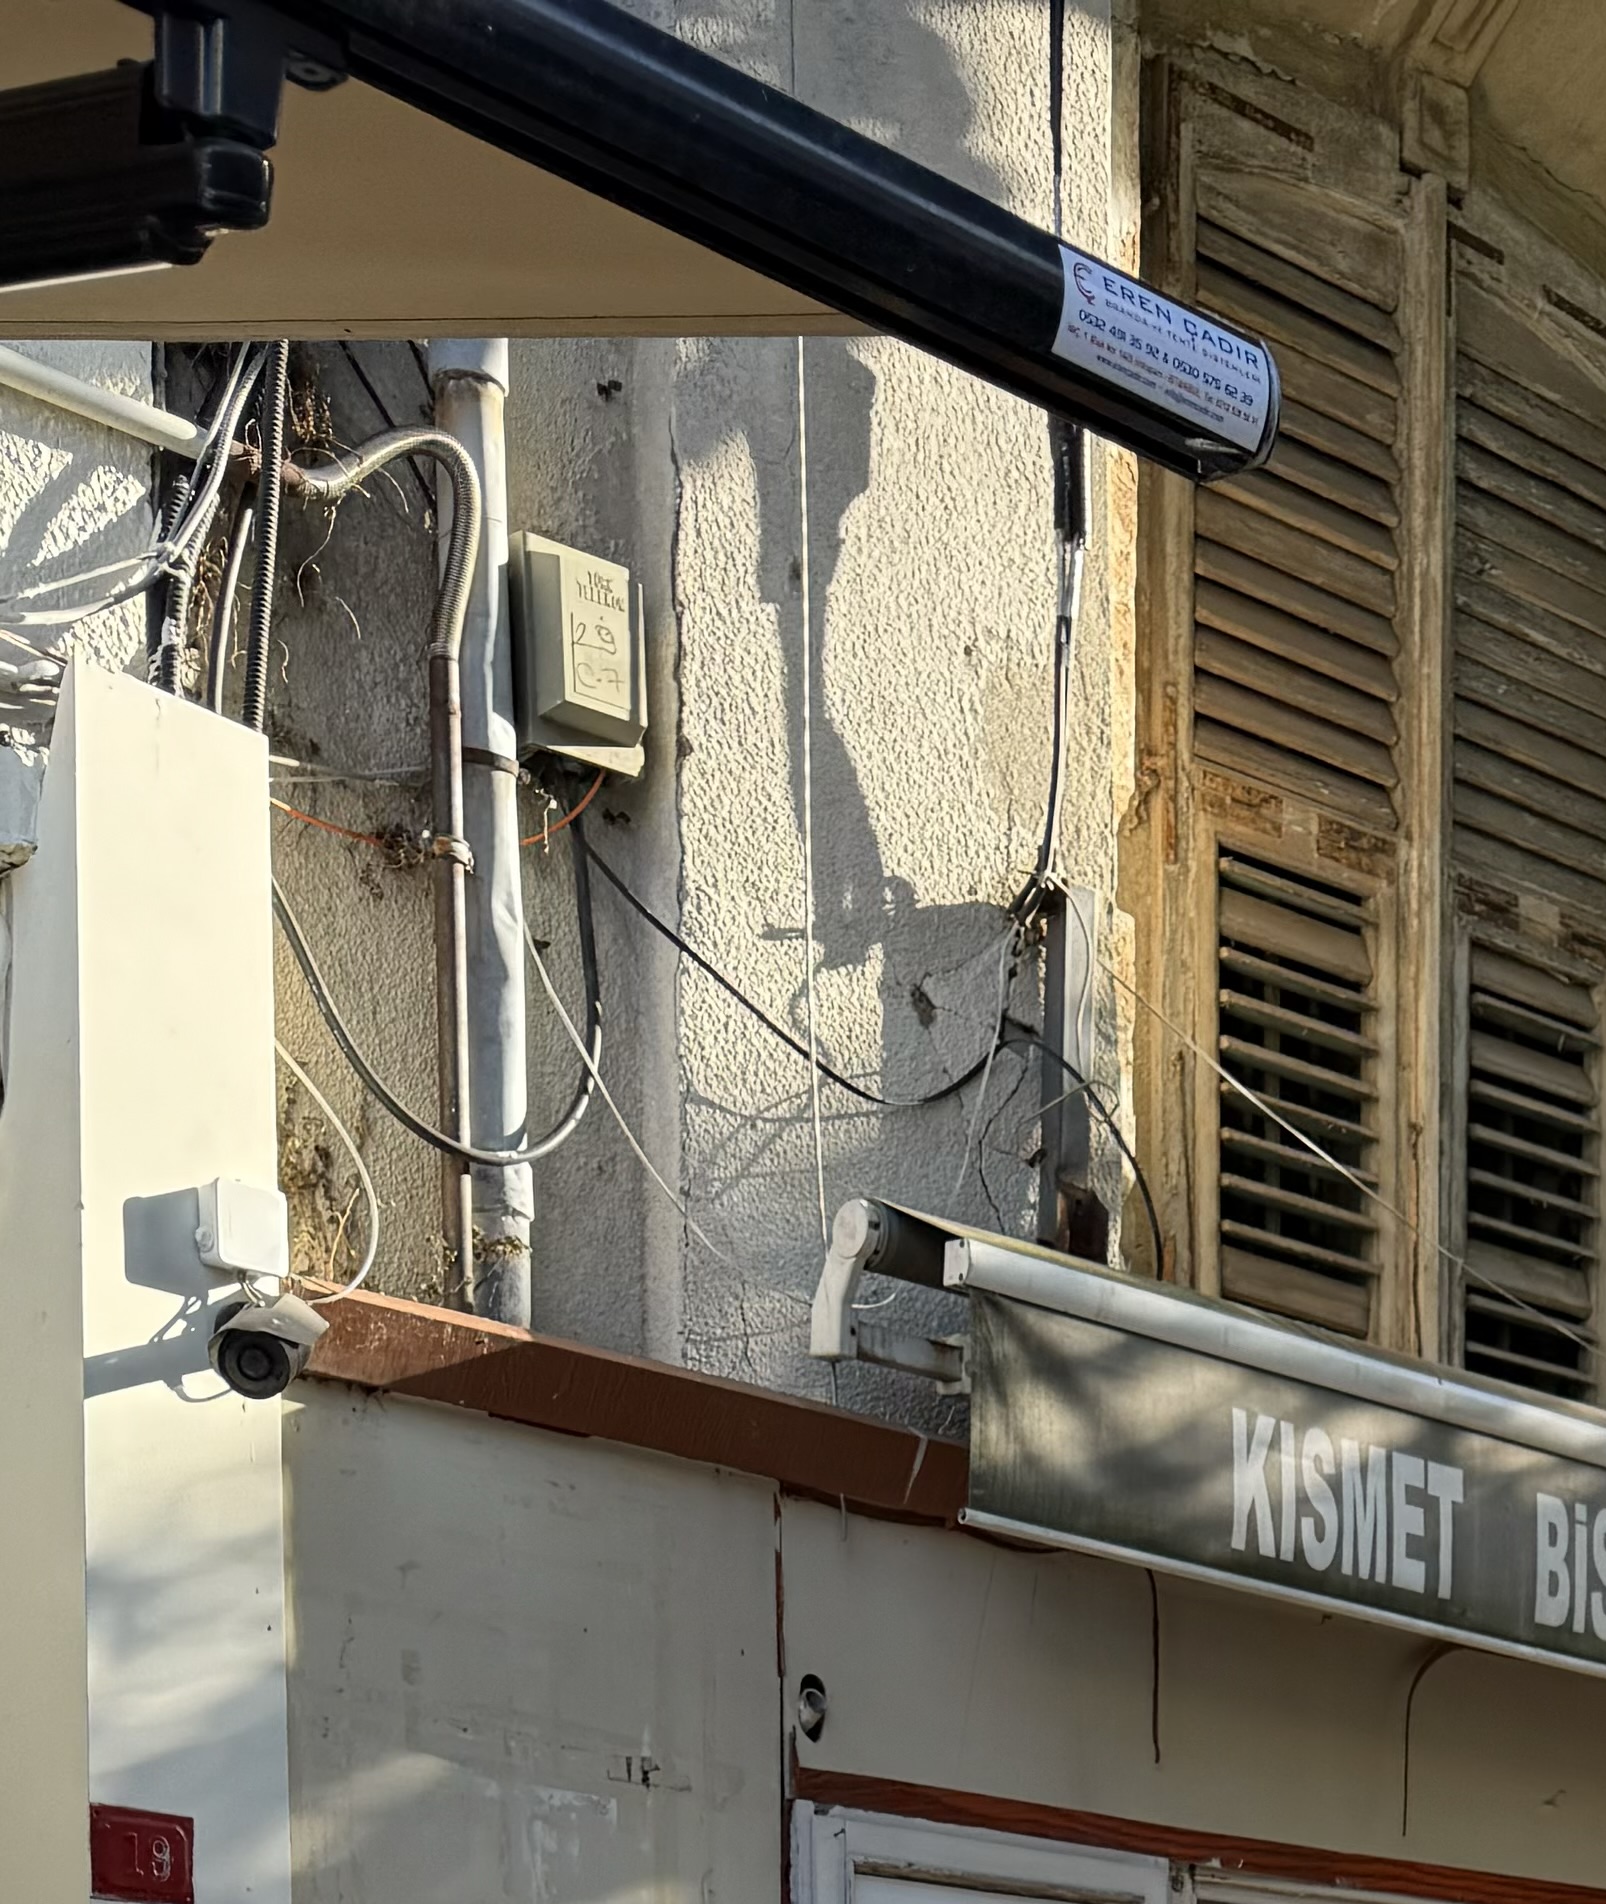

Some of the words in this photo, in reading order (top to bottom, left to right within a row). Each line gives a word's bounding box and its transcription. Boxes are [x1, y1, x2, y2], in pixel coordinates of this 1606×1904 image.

[1103, 276, 1171, 325] EREN
[1183, 317, 1259, 370] ÇADIR
[1231, 1407, 1465, 1600] KISMET
